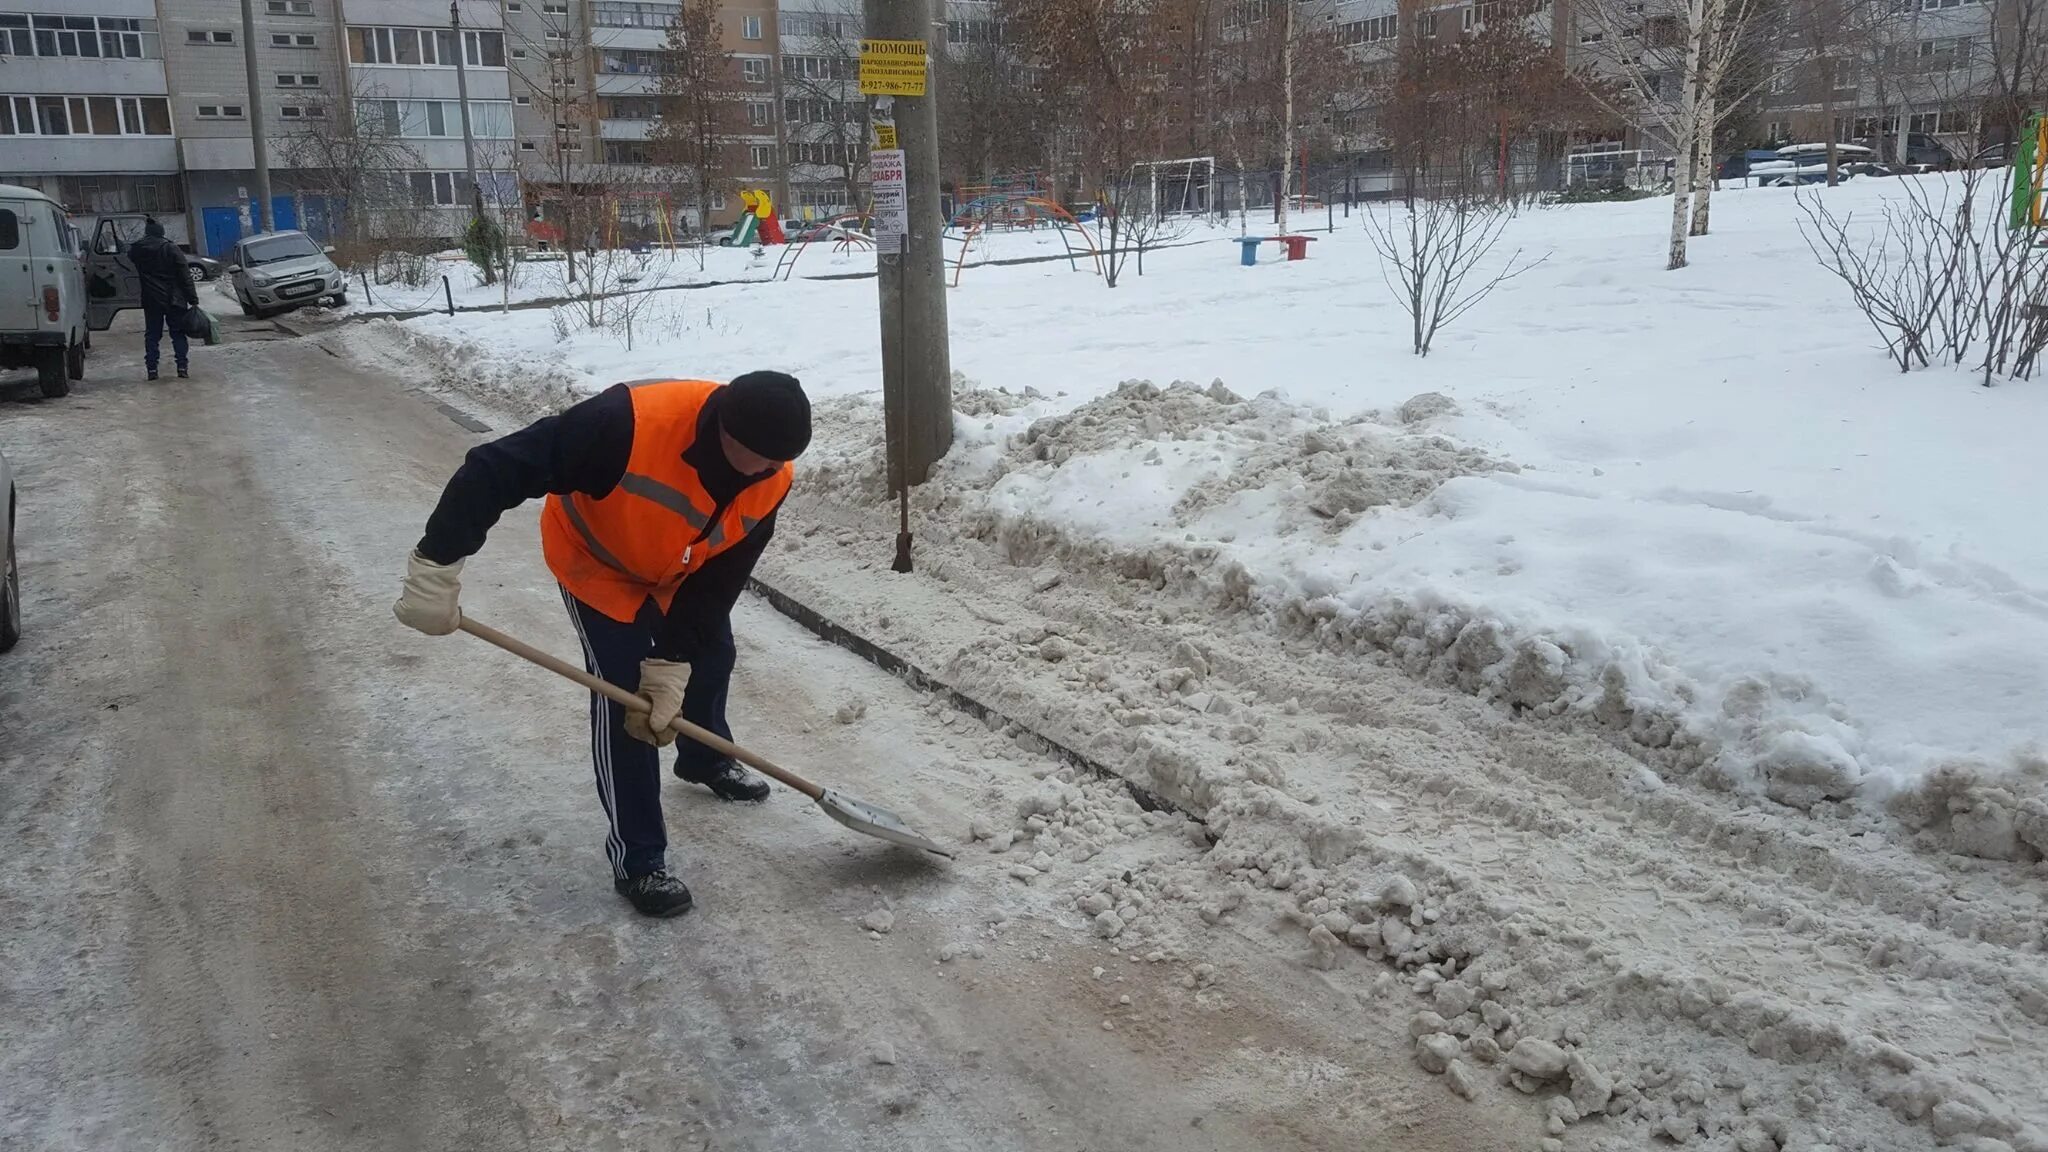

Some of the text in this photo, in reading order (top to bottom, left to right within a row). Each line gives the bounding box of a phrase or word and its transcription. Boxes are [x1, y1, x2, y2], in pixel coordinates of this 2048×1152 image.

[871, 43, 926, 55] ПОМОЩЬ
[861, 68, 925, 76] АЛКОЗАВИСИМЫМ
[861, 81, 924, 92] 8-927-986-77-77
